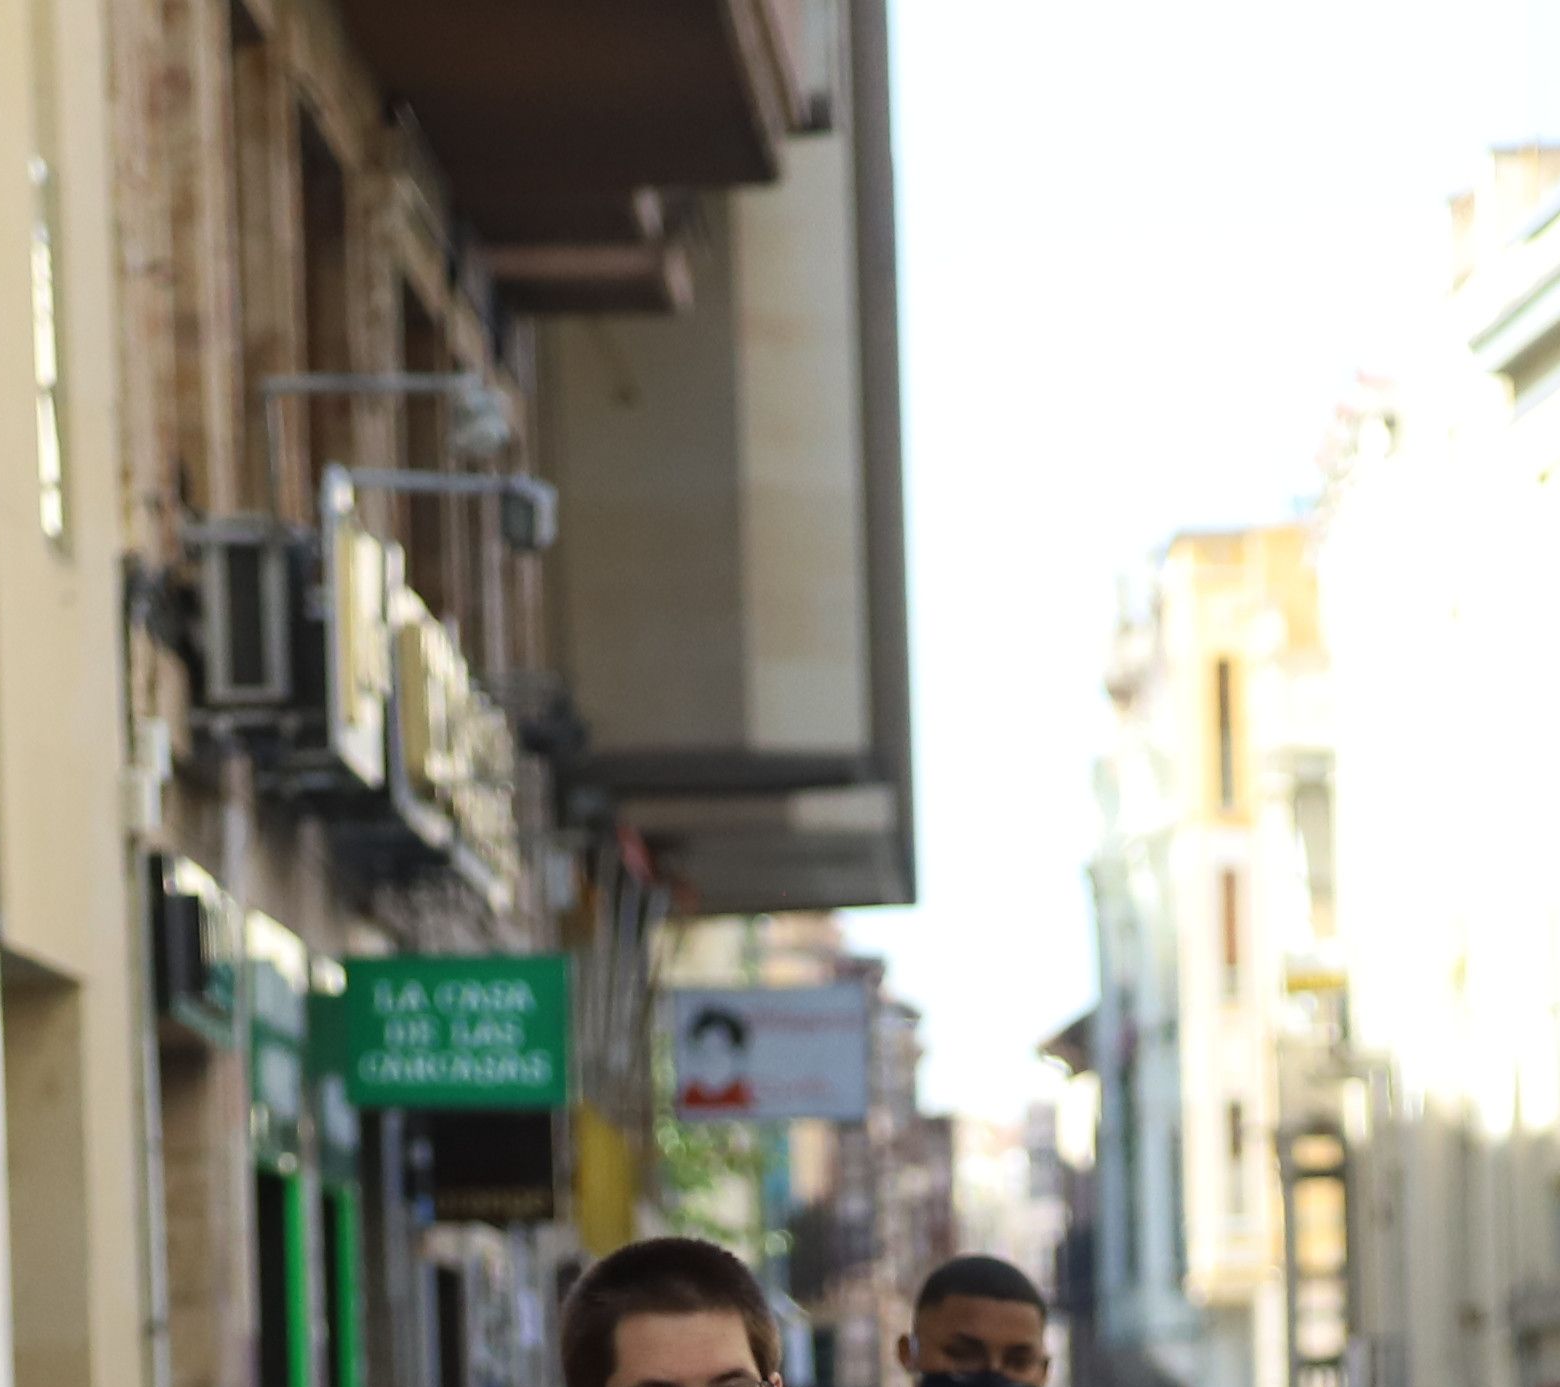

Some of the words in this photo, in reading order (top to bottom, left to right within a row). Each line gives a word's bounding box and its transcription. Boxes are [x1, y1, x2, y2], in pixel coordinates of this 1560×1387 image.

[373, 979, 429, 1013] LA
[434, 979, 536, 1014] CASA
[385, 1015, 438, 1049] DE
[450, 1016, 524, 1049] LAS
[358, 1050, 553, 1086] CARCASAS
